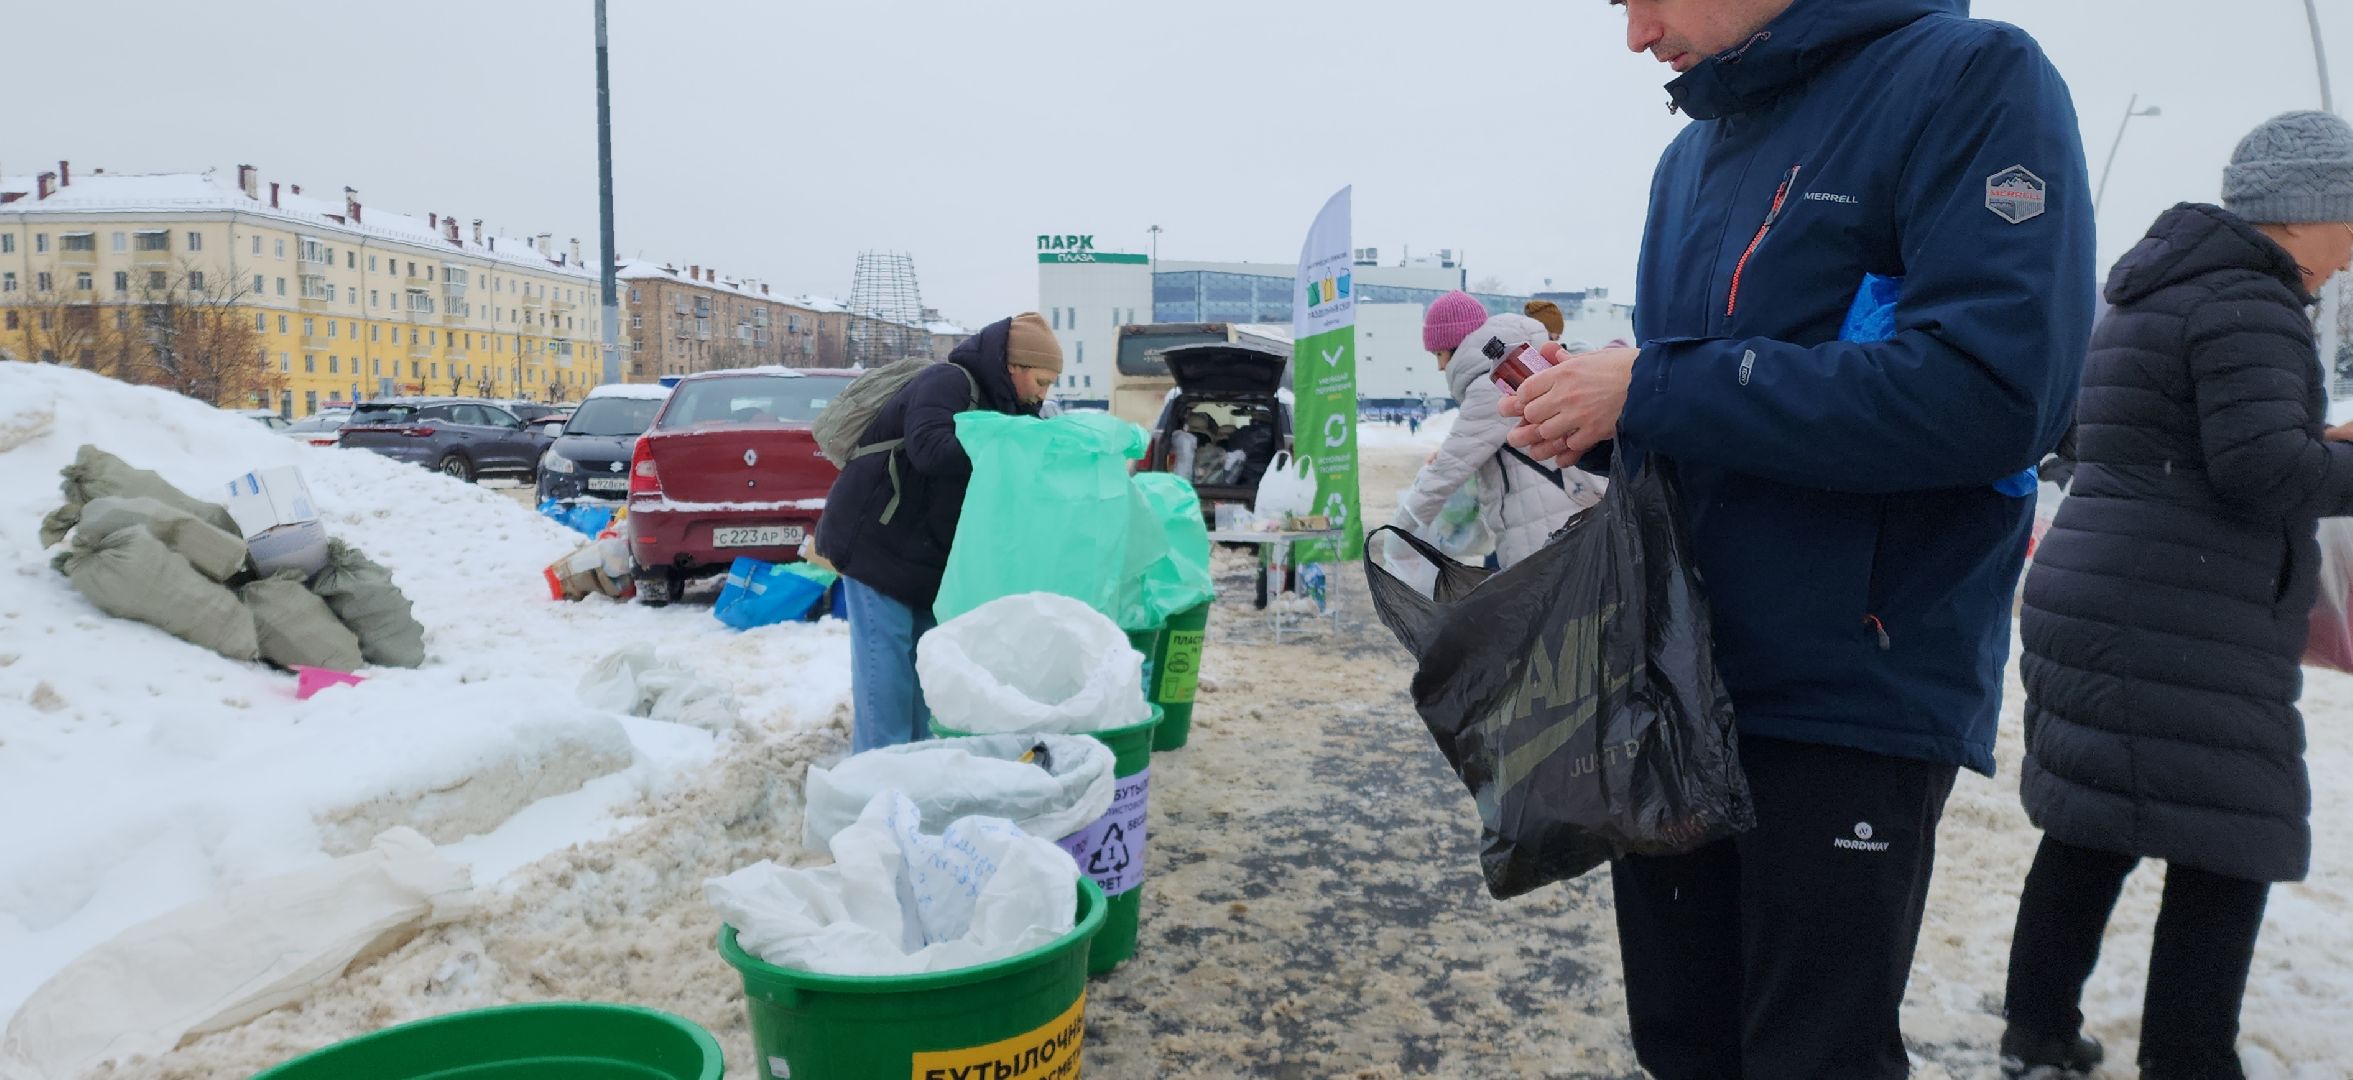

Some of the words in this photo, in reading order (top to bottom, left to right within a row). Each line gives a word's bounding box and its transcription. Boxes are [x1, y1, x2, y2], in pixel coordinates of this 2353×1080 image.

[1803, 191, 1859, 204] MERRELL
[1037, 234, 1094, 250] ПАРК
[1057, 253, 1096, 263] ПЛАЗА
[783, 527, 799, 539] 50
[1570, 744, 1618, 778] JUT
[1834, 837, 1889, 852] NORDWAY
[1108, 845, 1116, 860] 1
